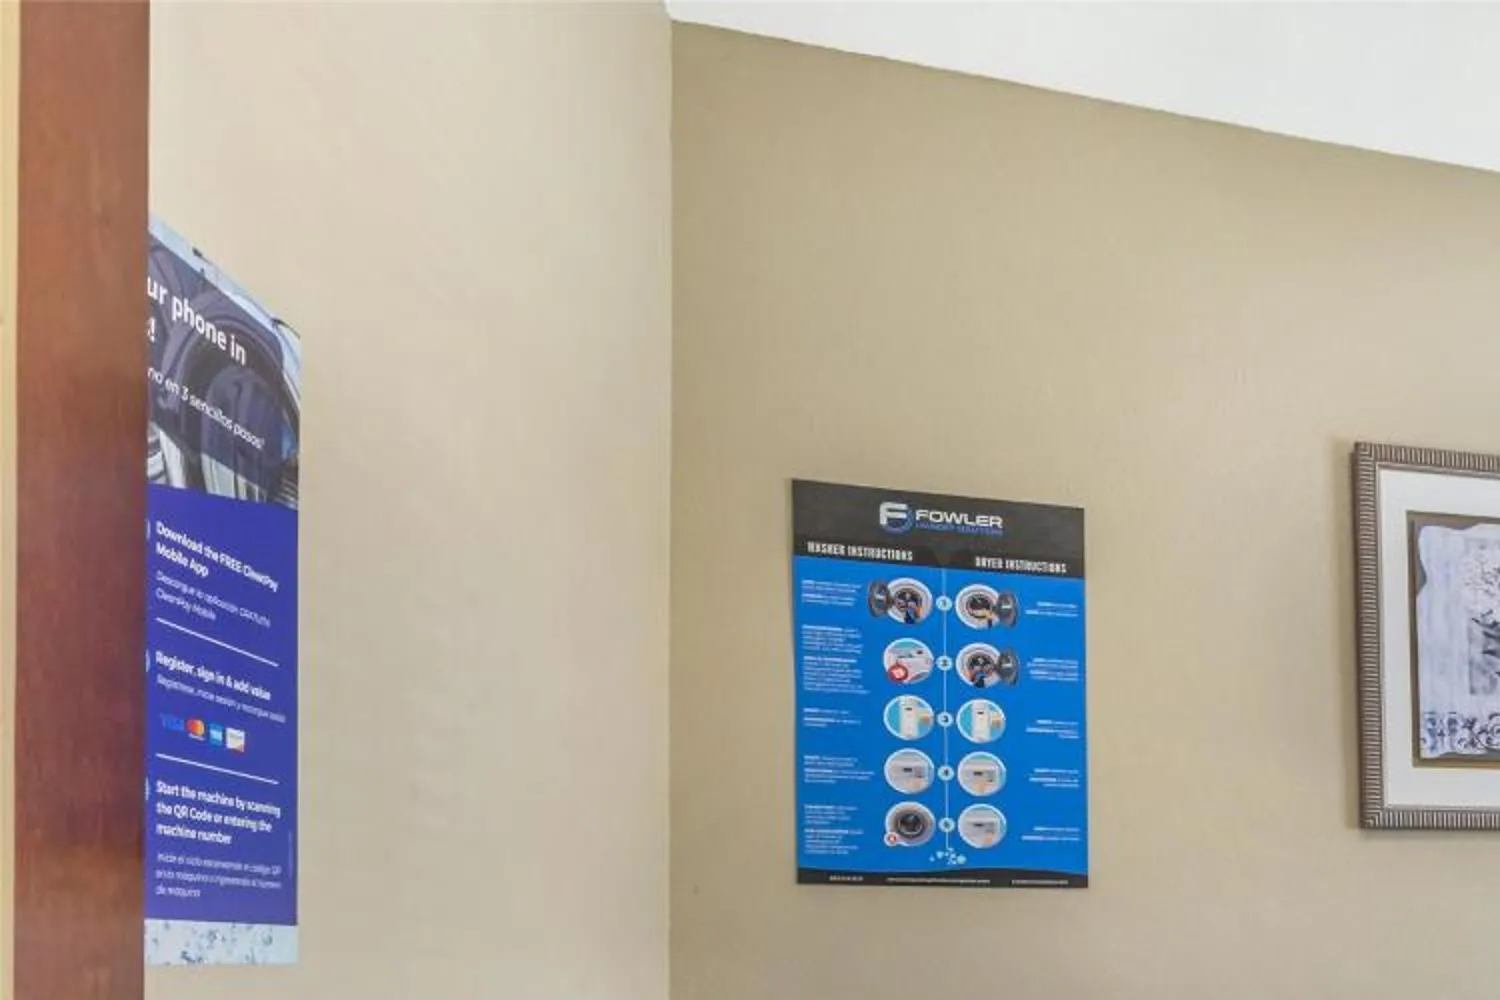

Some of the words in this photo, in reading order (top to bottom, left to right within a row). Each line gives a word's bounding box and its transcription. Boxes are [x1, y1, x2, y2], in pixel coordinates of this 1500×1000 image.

[172, 295, 227, 351] phone
[230, 334, 247, 366] in
[165, 380, 179, 395] en
[182, 386, 188, 401] 3
[915, 508, 1003, 529] FOWLER
[156, 520, 203, 554] Download
[204, 545, 219, 563] the
[220, 553, 242, 573] FREE
[807, 541, 846, 556] WASHER
[847, 544, 913, 562] INSTRUCTIONS
[156, 542, 188, 567] Mobile
[190, 558, 209, 578] App
[1005, 558, 1067, 574] INSTRUCTIONS
[197, 665, 215, 683] sign
[156, 780, 179, 797] Start
[181, 786, 196, 799] the
[197, 789, 234, 807] machine
[235, 796, 246, 811] by
[156, 802, 172, 815] the
[174, 804, 188, 819] QR
[190, 807, 212, 822] Code
[213, 814, 223, 823] or
[224, 815, 257, 832] entering
[156, 824, 196, 839] machine
[197, 830, 233, 844] number
